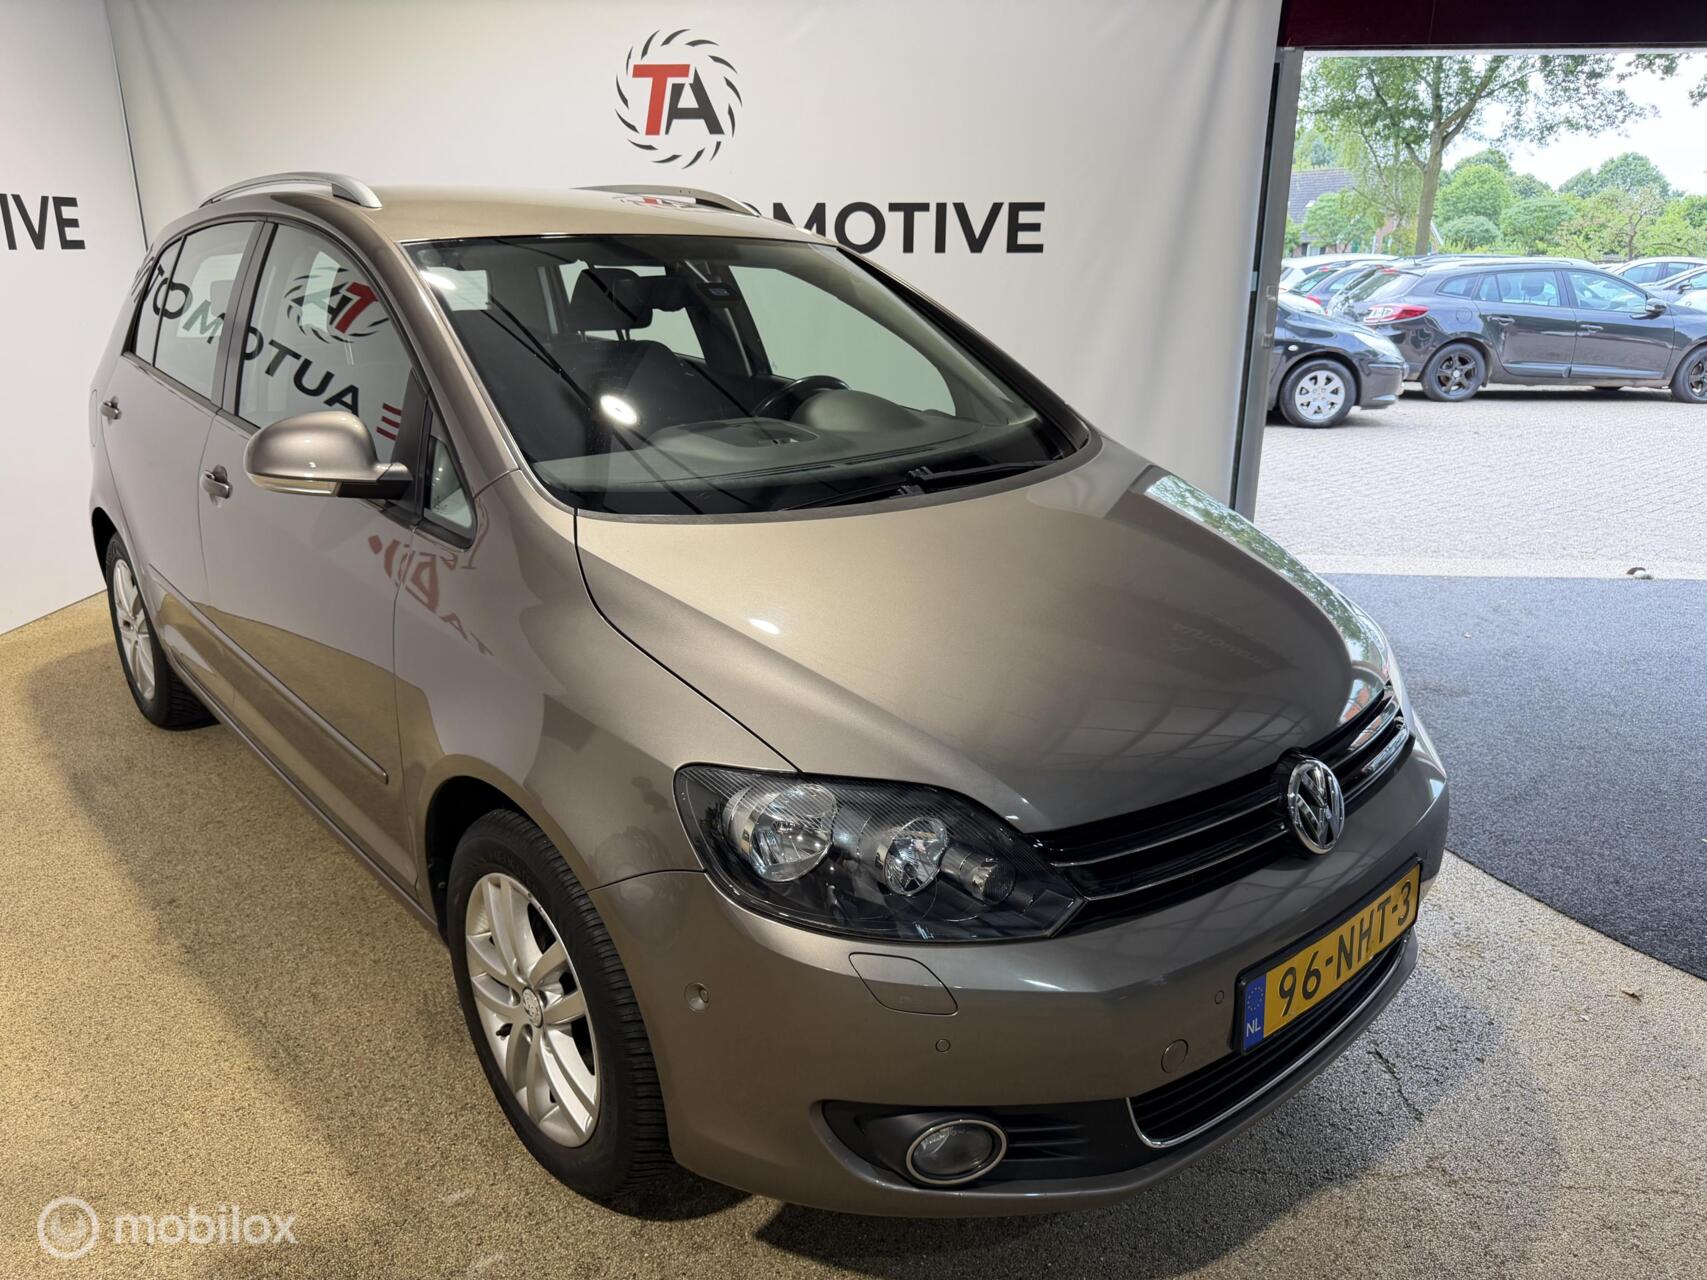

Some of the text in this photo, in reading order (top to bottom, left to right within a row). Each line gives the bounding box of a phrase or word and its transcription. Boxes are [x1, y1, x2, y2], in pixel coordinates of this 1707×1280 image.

[632, 64, 725, 136] TA
[1279, 880, 1412, 1017] 96-NHT-3
[1245, 1022, 1262, 1038] NL
